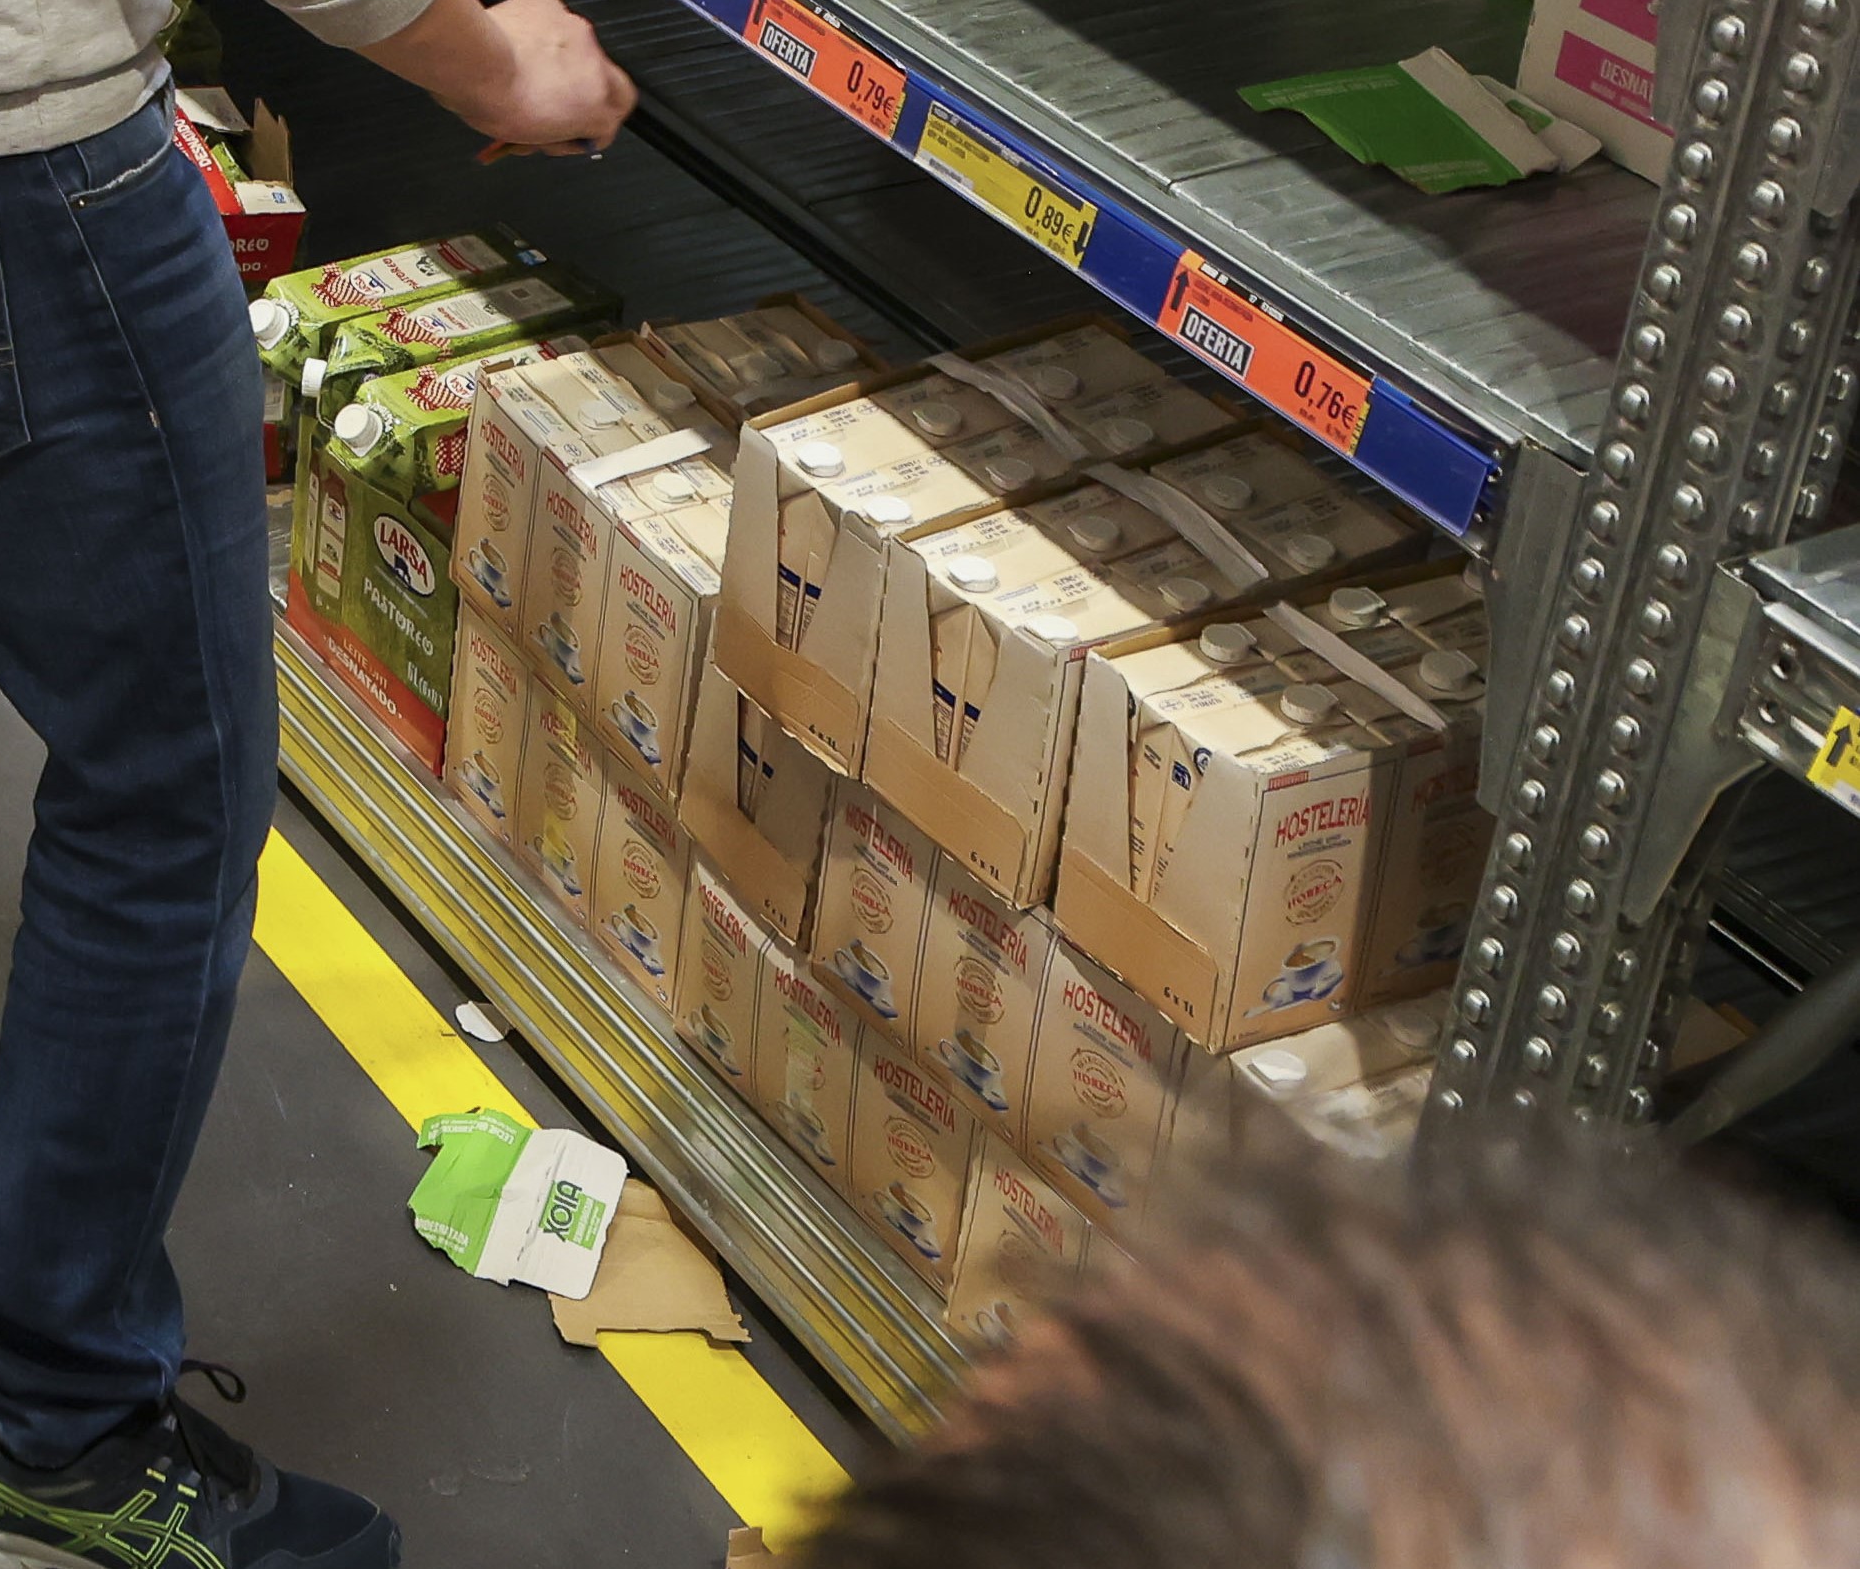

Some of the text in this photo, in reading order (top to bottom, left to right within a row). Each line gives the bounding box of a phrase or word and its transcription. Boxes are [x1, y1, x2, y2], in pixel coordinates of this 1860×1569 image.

[763, 24, 896, 118] OFERTA 0,79€
[1024, 184, 1074, 243] 0,89€
[1184, 310, 1358, 427] OFERTA 0,76€
[379, 523, 429, 587] LARSA
[546, 489, 598, 560] HOSTELERÍA
[363, 577, 434, 656] PASTOREO
[619, 564, 677, 636] HOSTELERÍA
[327, 638, 398, 719] DESNATADO
[846, 800, 914, 883] HOSTELERÍA
[1276, 790, 1370, 849] HOSTELERÍA
[1287, 871, 1343, 910] HORECA
[950, 887, 1029, 975] HOSTELERÍA
[1063, 978, 1154, 1062] HOSTELERÍA
[874, 1054, 957, 1132] HOSTELERÍA
[542, 1179, 582, 1243] XOIA
